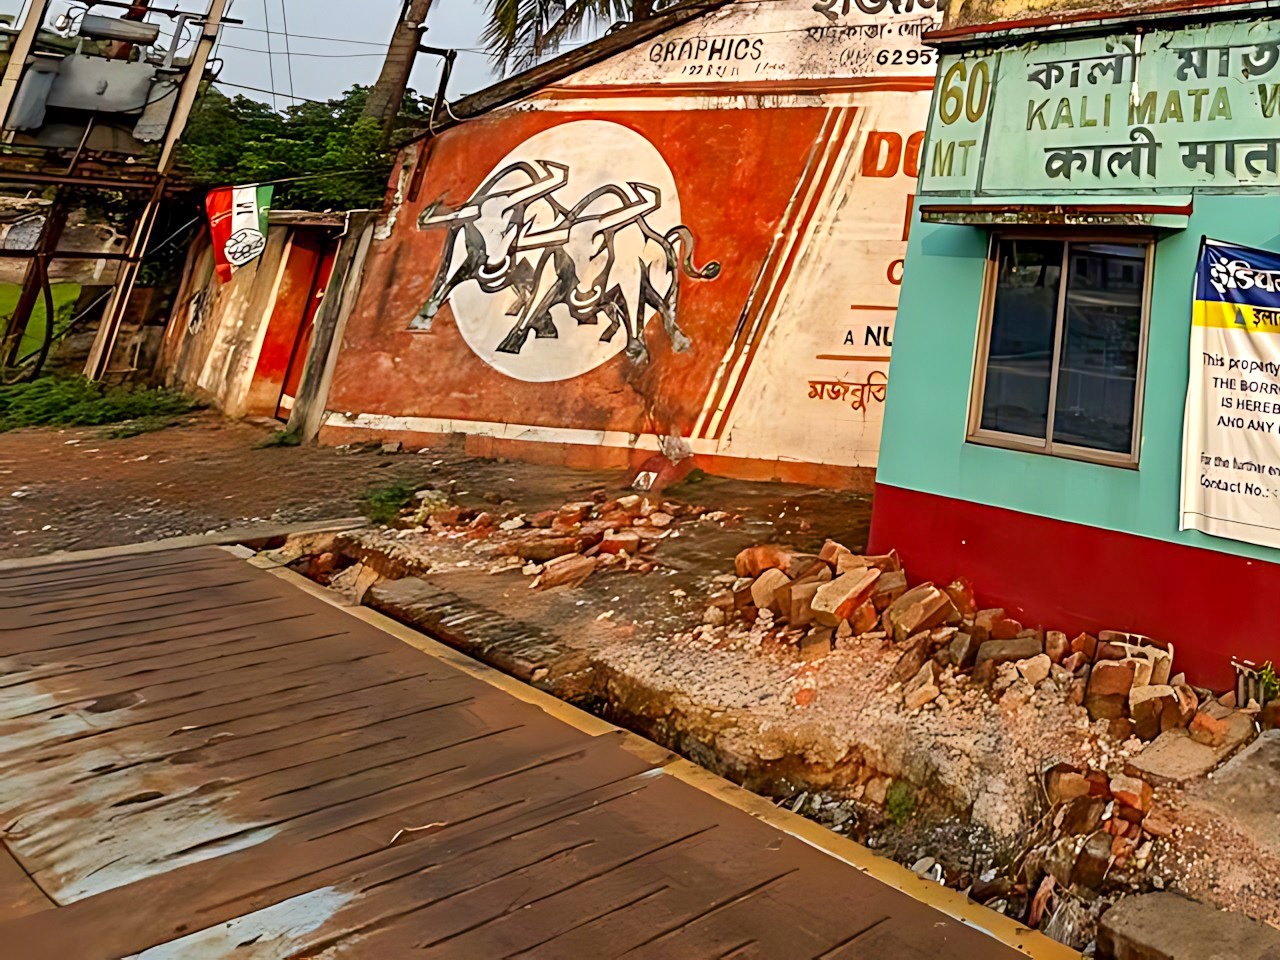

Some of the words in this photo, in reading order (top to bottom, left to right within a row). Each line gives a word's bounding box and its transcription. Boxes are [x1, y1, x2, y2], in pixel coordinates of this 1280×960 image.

[649, 38, 764, 63] GRAPHICS
[876, 48, 940, 66] 6295
[939, 60, 990, 126] 60
[1026, 92, 1112, 131] KALI
[1127, 86, 1233, 127] MATA
[931, 137, 977, 178] MT
[1044, 126, 1163, 181] काली
[843, 329, 855, 346] A
[1203, 352, 1225, 368] This
[1228, 356, 1280, 377] property
[1212, 376, 1237, 391] THE
[1221, 396, 1233, 409] IS
[1217, 415, 1244, 429] AND
[1247, 418, 1275, 434] ANY
[1200, 473, 1241, 494] Contact
